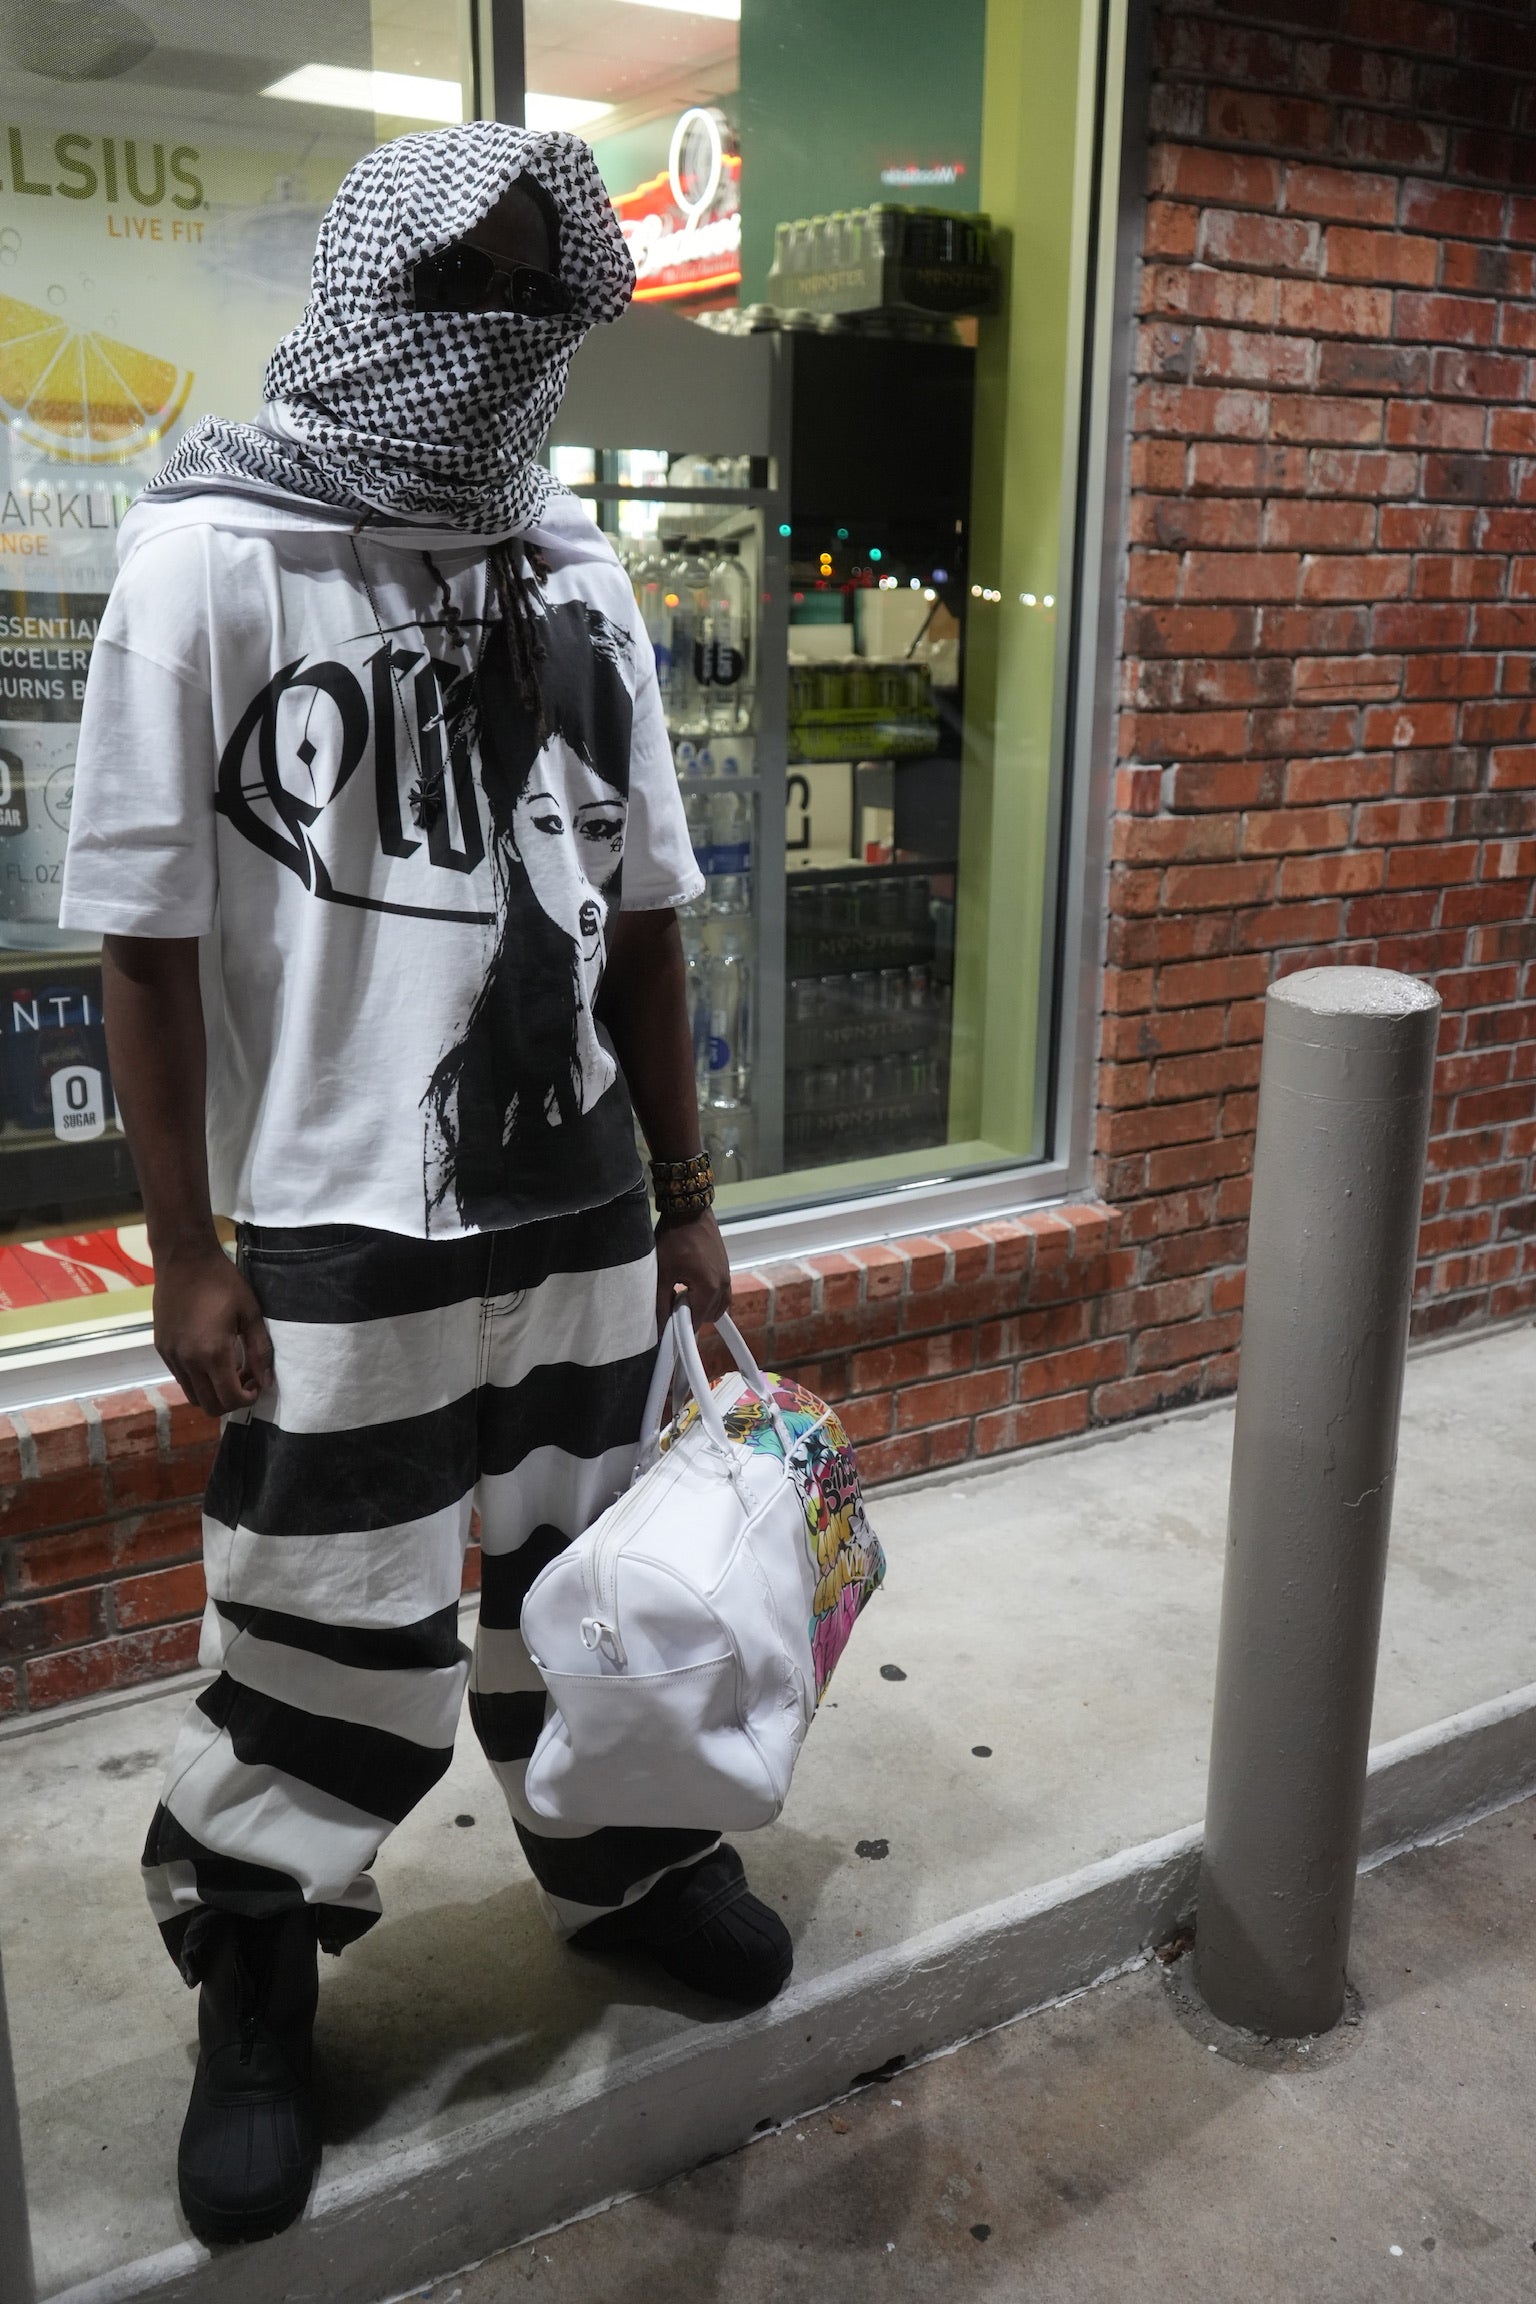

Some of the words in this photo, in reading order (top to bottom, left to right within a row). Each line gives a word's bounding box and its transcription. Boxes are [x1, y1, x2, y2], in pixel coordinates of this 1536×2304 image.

[0, 126, 204, 210] LSIUS
[107, 215, 164, 241] LIVE
[171, 220, 205, 244] FIT
[0, 677, 66, 700] URNS
[816, 930, 915, 956] MONSTER
[0, 994, 104, 1034] NTI
[66, 1075, 88, 1110] 0
[62, 1112, 97, 1129] SUGAR
